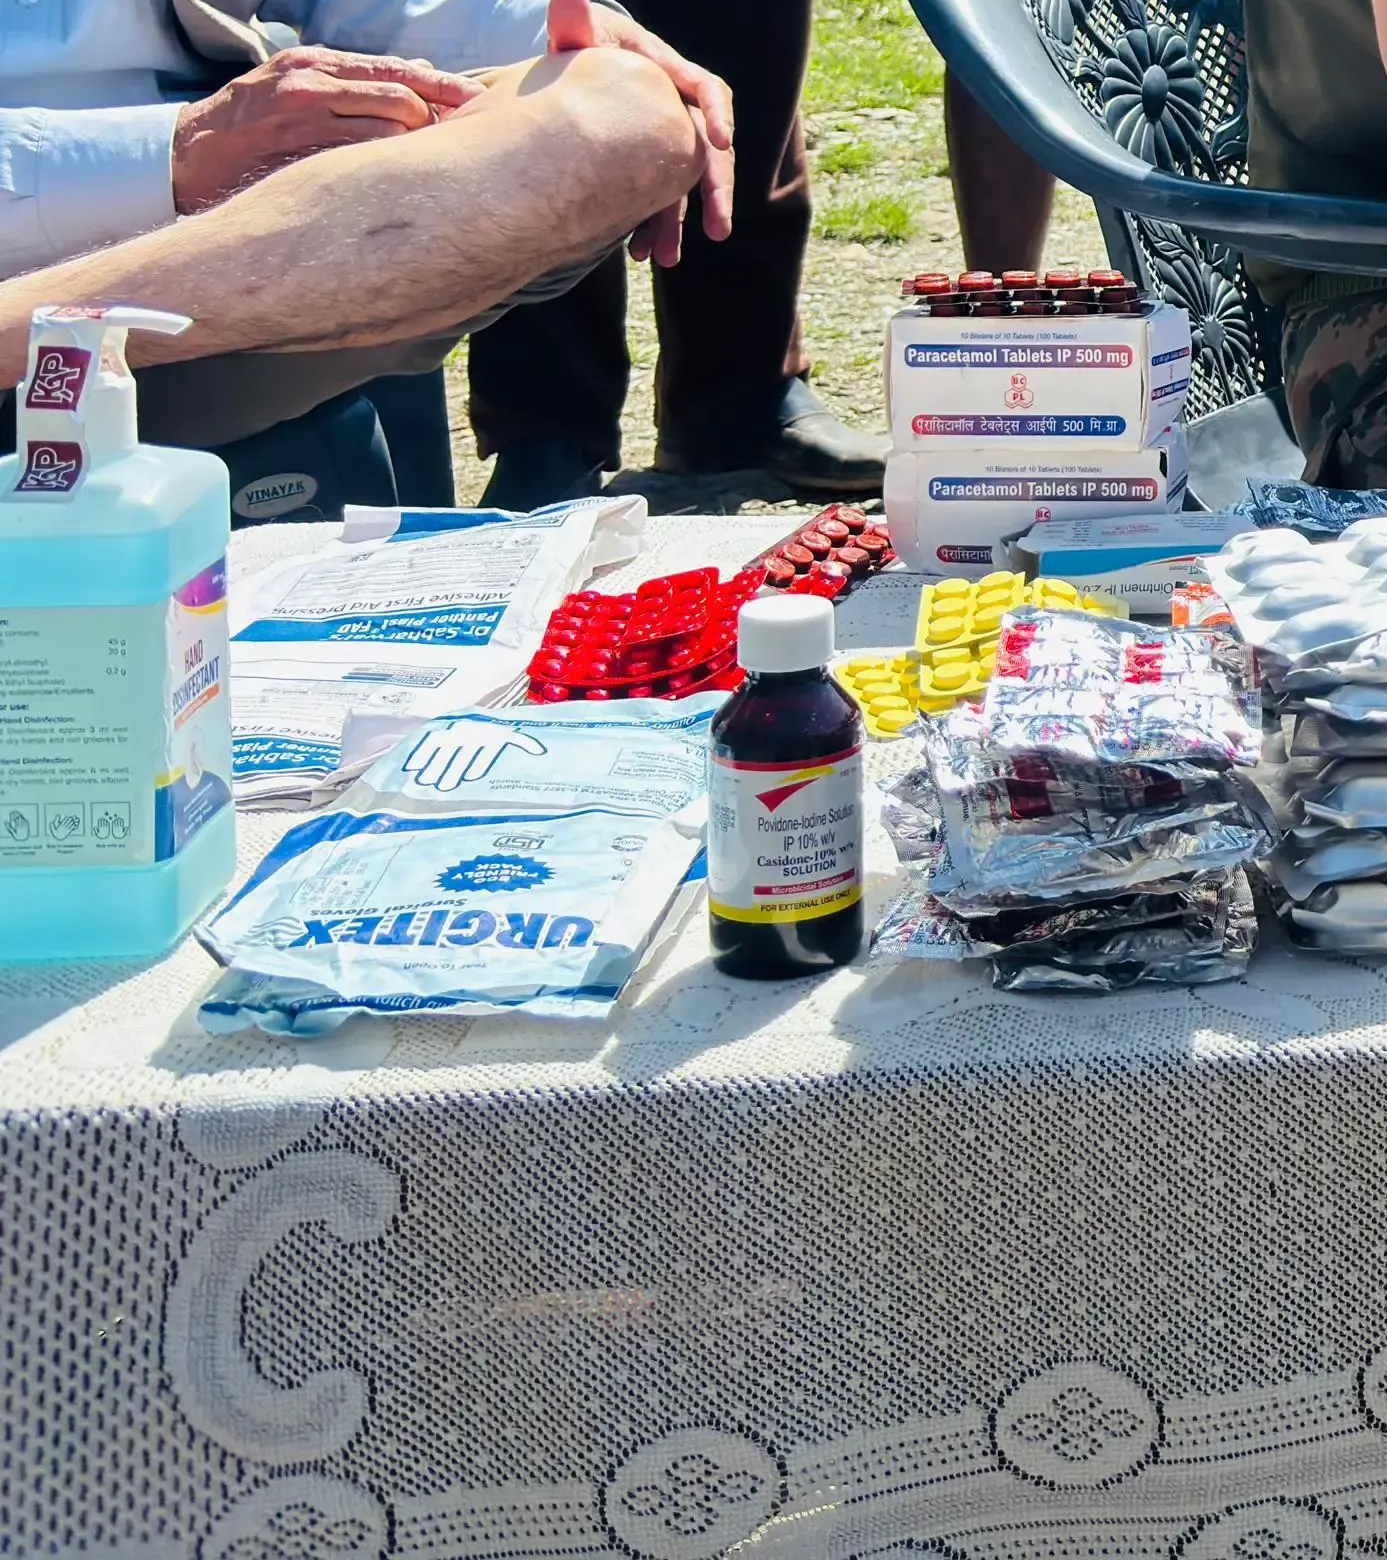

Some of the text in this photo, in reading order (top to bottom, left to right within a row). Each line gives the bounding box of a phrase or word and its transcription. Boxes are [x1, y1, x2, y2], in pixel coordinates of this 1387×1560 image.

[908, 348, 1129, 366] Paracetamol Tablets IP 500 mg
[1012, 376, 1025, 386] BC
[1013, 392, 1026, 401] PL
[1062, 420, 1084, 432] 500
[245, 481, 305, 502] VINAYAK
[932, 481, 1154, 500] Paracetamol Tablets IP 500 mg
[1120, 582, 1174, 594] Ointment
[385, 597, 426, 608] First
[428, 592, 512, 602] Adhesive
[351, 602, 383, 612] Aid
[337, 612, 499, 633] Panther Plast FAD
[464, 626, 491, 636] Dr
[184, 639, 204, 675] HAND
[172, 655, 220, 717] DISINFECTANT
[279, 728, 342, 740] hesive
[232, 742, 342, 754] anther Plas
[312, 755, 340, 764] Dr
[758, 812, 827, 832] Povidone-Iodine
[784, 831, 836, 851] IP 10% w/v
[757, 850, 836, 867] Casidone-10%
[476, 863, 524, 872] PACK
[783, 859, 836, 876] SOLUTION
[451, 869, 538, 880] FRIENDLY
[772, 883, 817, 894] Microbicidal
[310, 899, 468, 917] Surgical Gloves
[760, 903, 777, 912] FOR
[778, 899, 819, 911] EXTERNAL
[821, 896, 835, 905] USE
[287, 910, 597, 950] URGITEX
